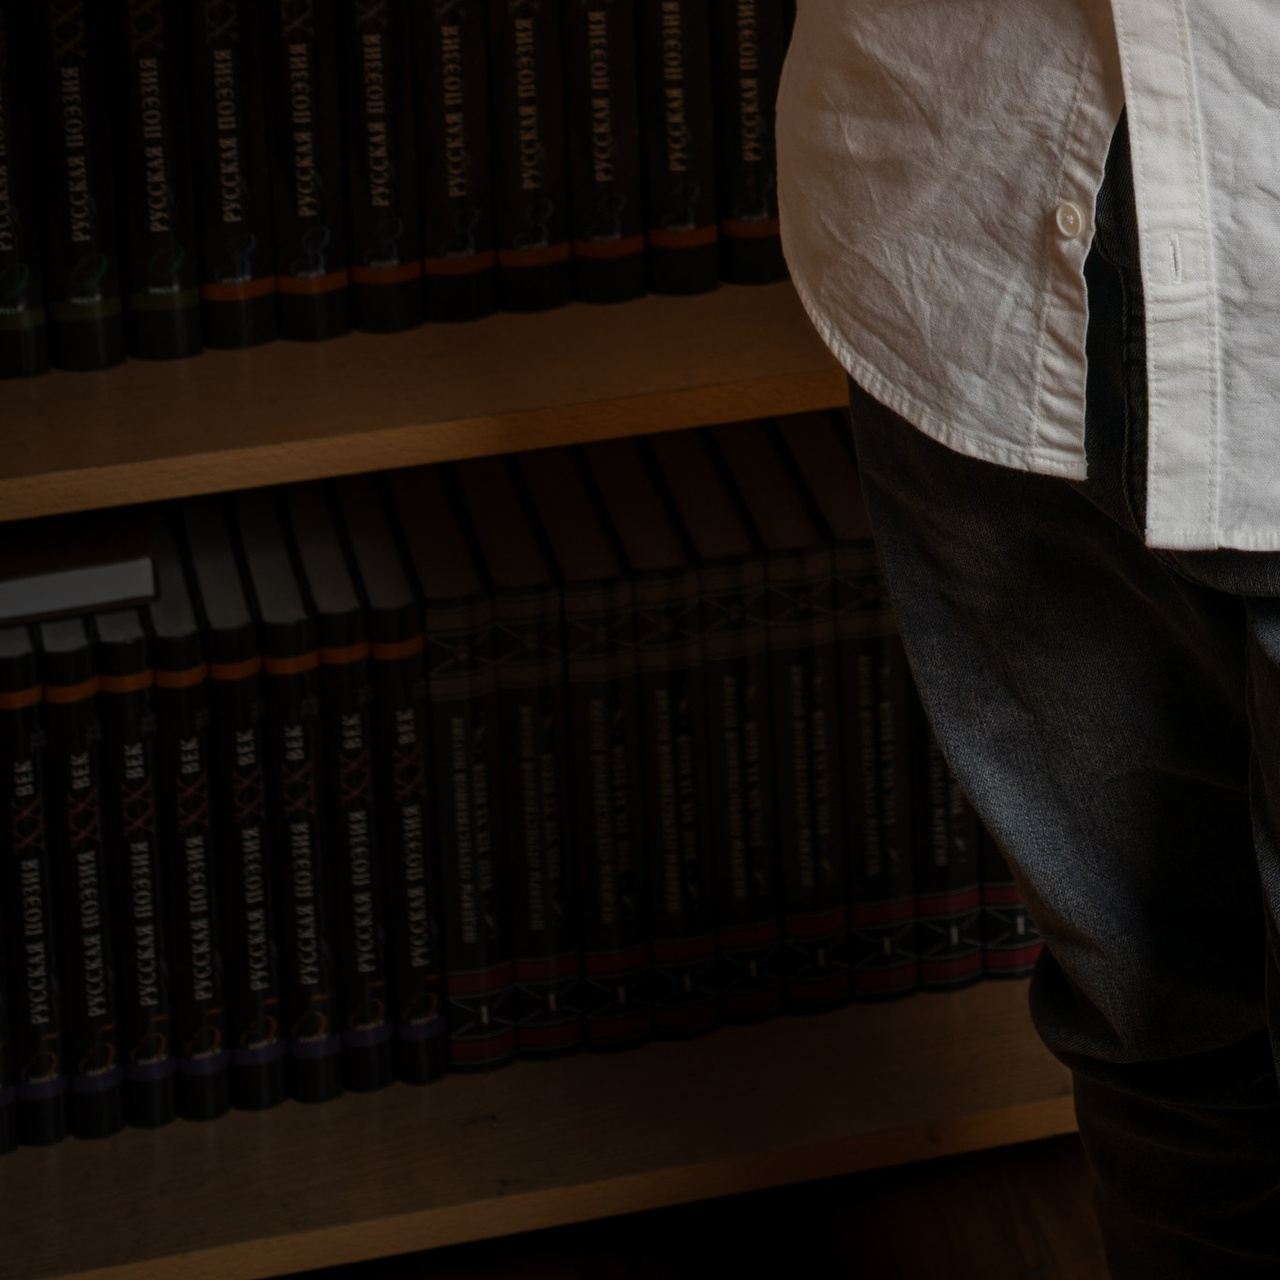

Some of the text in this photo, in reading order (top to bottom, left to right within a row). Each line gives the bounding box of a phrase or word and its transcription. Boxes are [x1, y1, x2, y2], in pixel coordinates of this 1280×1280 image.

[213, 50, 237, 130] ПОЭЗИЯ
[288, 43, 311, 123] ПОЭЗИЯ
[362, 34, 386, 115] ПОЭЗИЯ
[441, 26, 463, 105] ПОЭЗИЯ
[587, 10, 610, 90] ПОЭЗИЯ
[218, 137, 242, 223] РУССКАЯ
[295, 131, 317, 217] РУССКАЯ
[366, 122, 391, 207] РУССКАЯ
[444, 113, 468, 198] РУССКАЯ
[591, 97, 614, 183] РУССКАЯ
[70, 752, 92, 790] ВЕК
[124, 741, 145, 779] ВЕК
[235, 728, 256, 766] ВЕК
[341, 712, 363, 750] ВЕК
[13, 760, 35, 797] ВЕК
[130, 841, 154, 919] ПОЭЗИЯ
[241, 826, 265, 903] ПОЭЗИЯ
[347, 810, 371, 886] ПОЭЗИЯ
[19, 858, 44, 936] ПОЭЗИЯ
[76, 850, 101, 930] ПОЭЗИЯ
[134, 925, 159, 1007] РУССКАЯ
[245, 908, 269, 990] РУССКАЯ
[352, 891, 376, 973] РУССКАЯ
[25, 942, 50, 1024] РУССКАЯ
[82, 934, 107, 1017] РУССКАЯ
